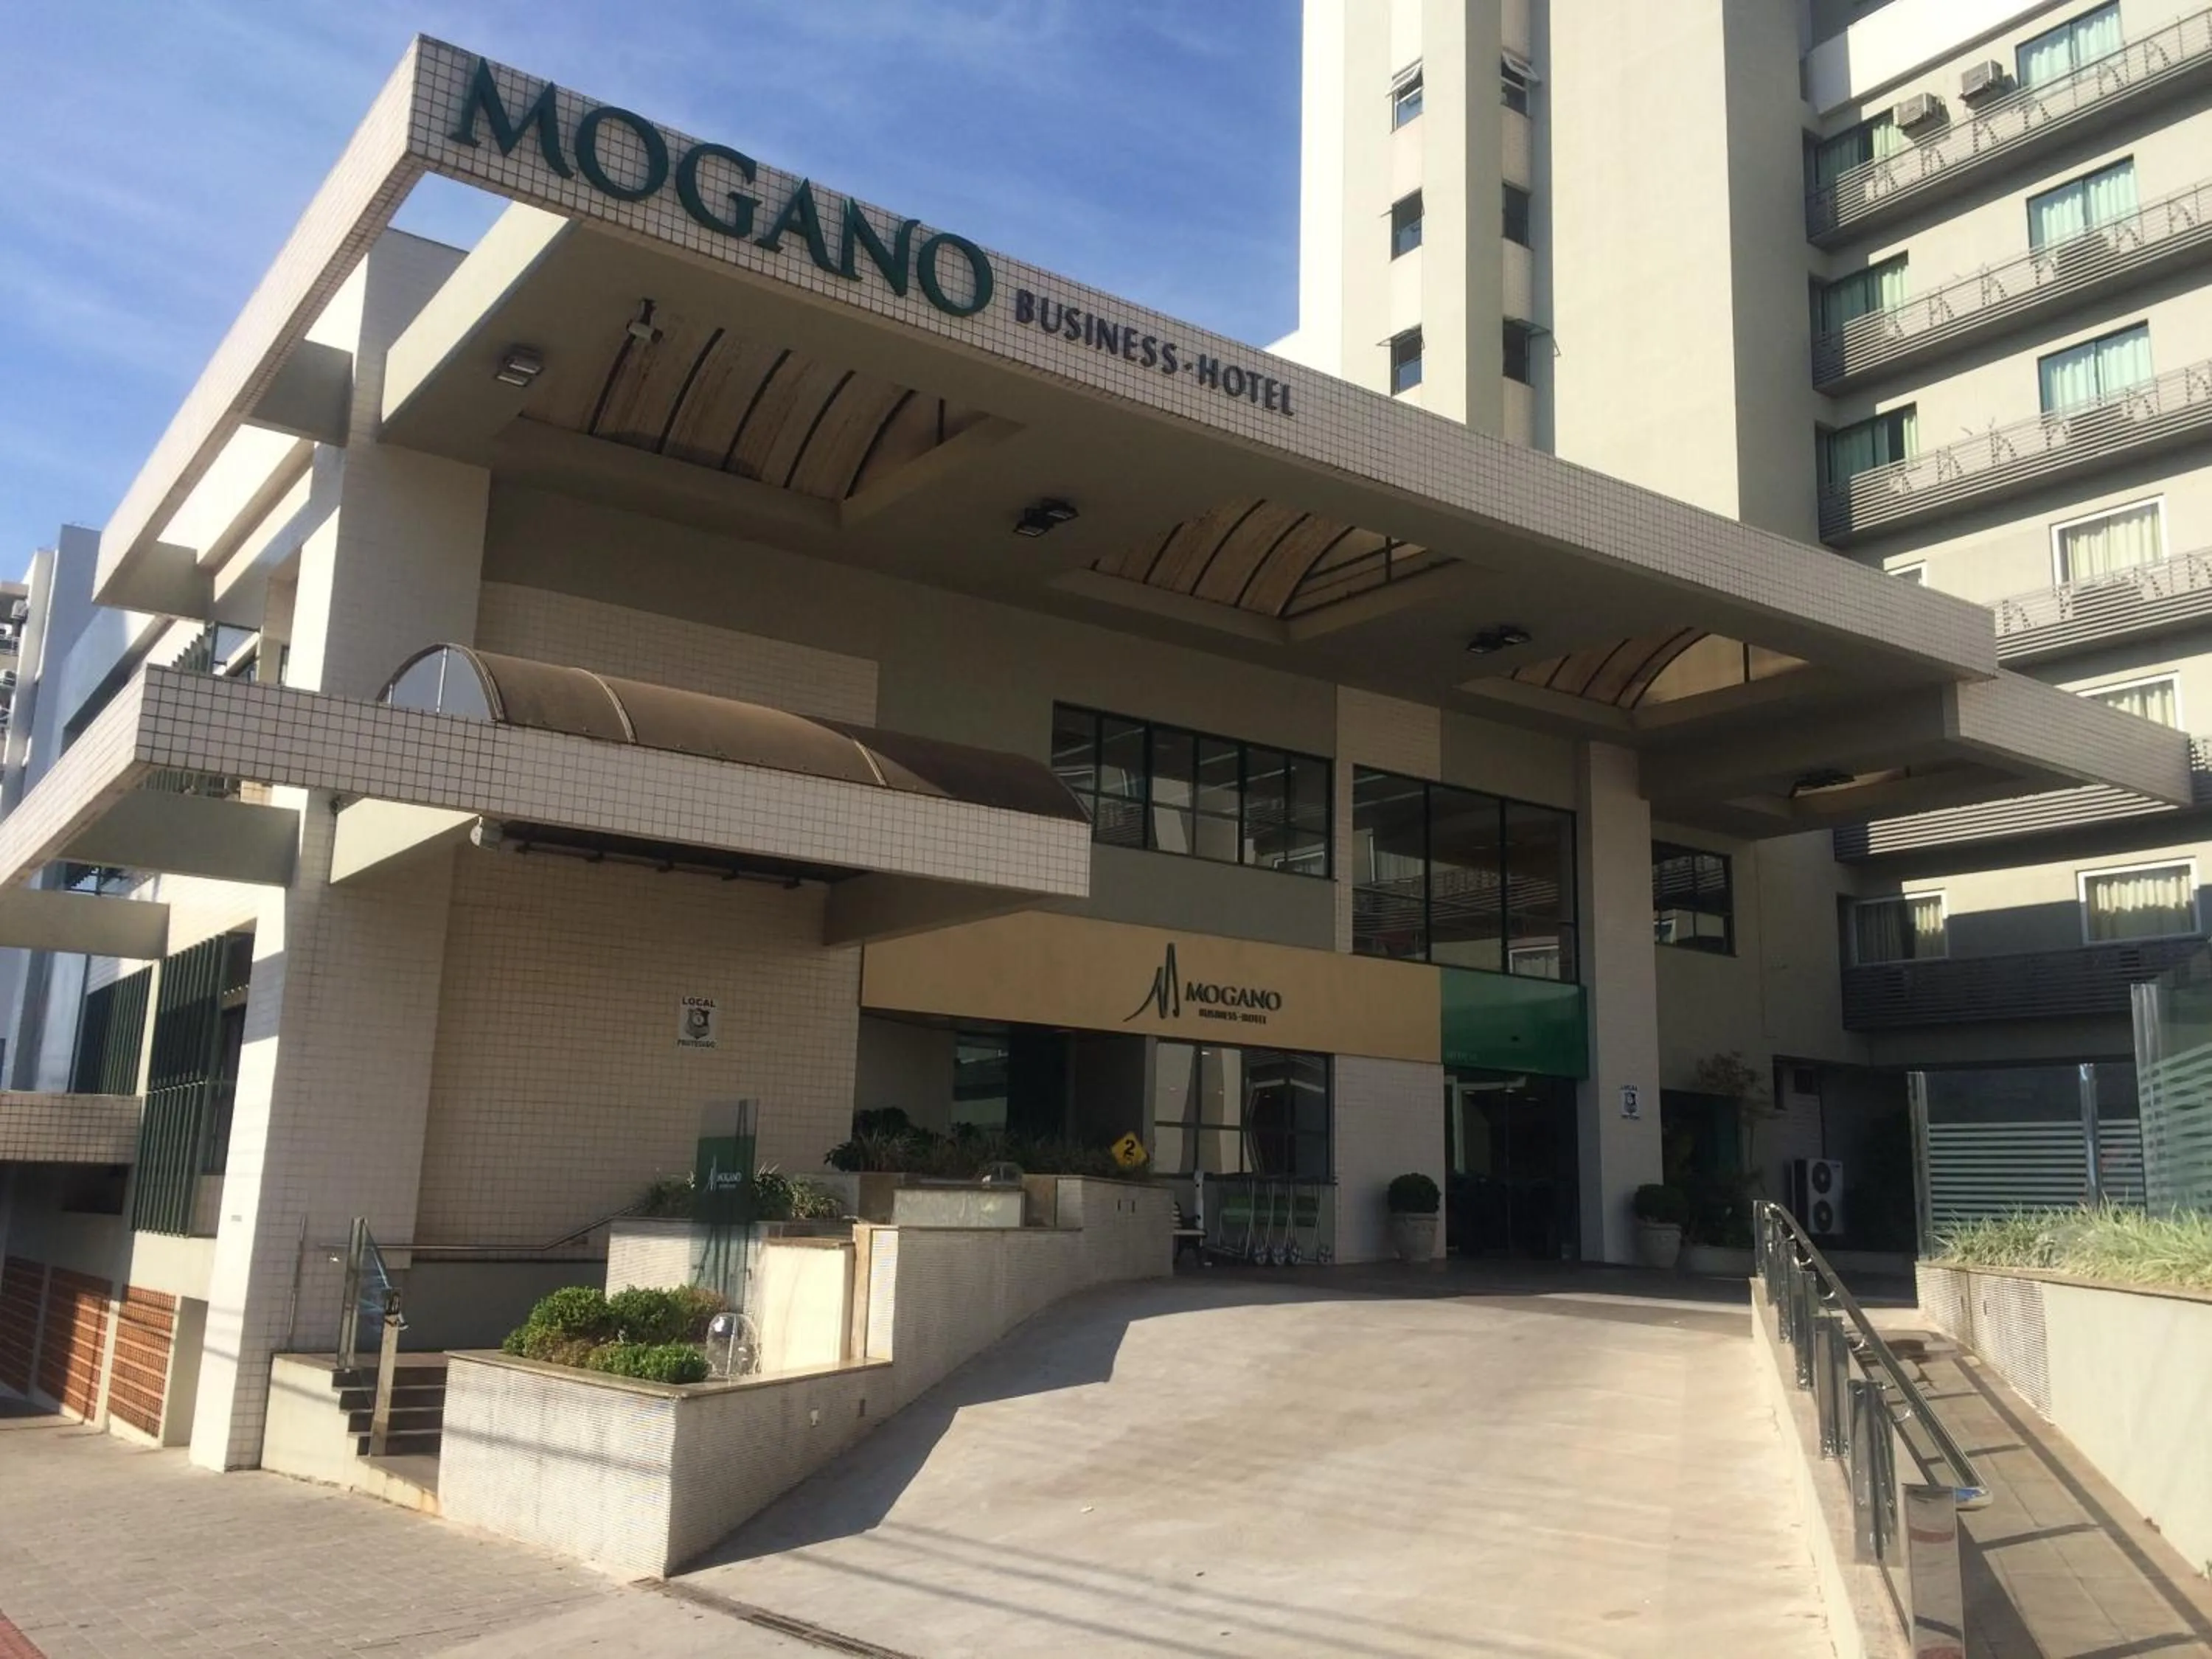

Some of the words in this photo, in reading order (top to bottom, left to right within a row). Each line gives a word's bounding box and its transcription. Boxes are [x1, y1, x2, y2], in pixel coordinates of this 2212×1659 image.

[448, 56, 994, 317] MOGANO
[682, 996, 716, 1008] LOCAL
[1185, 981, 1282, 1011] MOGANO
